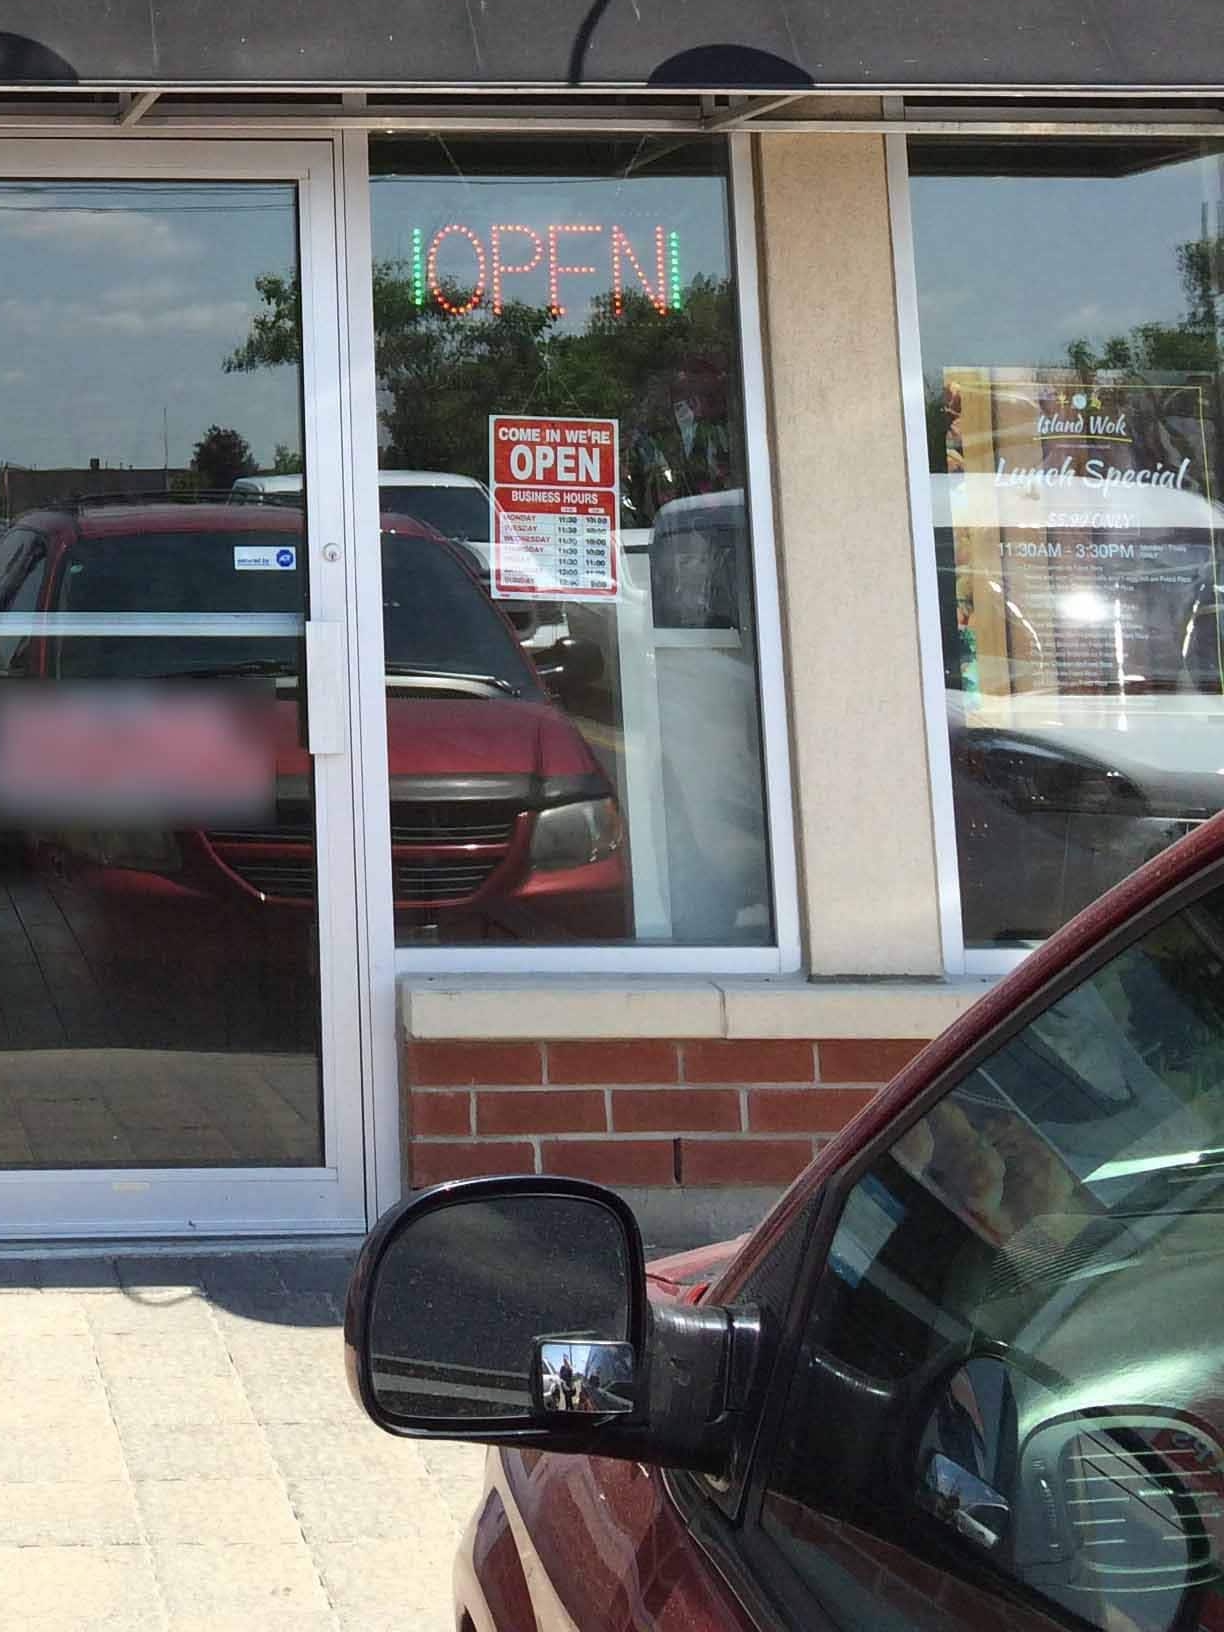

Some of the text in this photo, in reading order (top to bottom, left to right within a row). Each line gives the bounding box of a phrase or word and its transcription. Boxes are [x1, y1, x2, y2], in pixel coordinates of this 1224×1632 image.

[1036, 413, 1128, 436] Island Wok
[498, 427, 611, 444] COME IN WE'RE
[510, 444, 601, 483] OPEN
[992, 455, 1192, 498] Lunch Special
[511, 490, 599, 505] BUSINESS HOURS
[999, 542, 1062, 558] 11:30AM
[1076, 543, 1135, 559] 3:30PM
